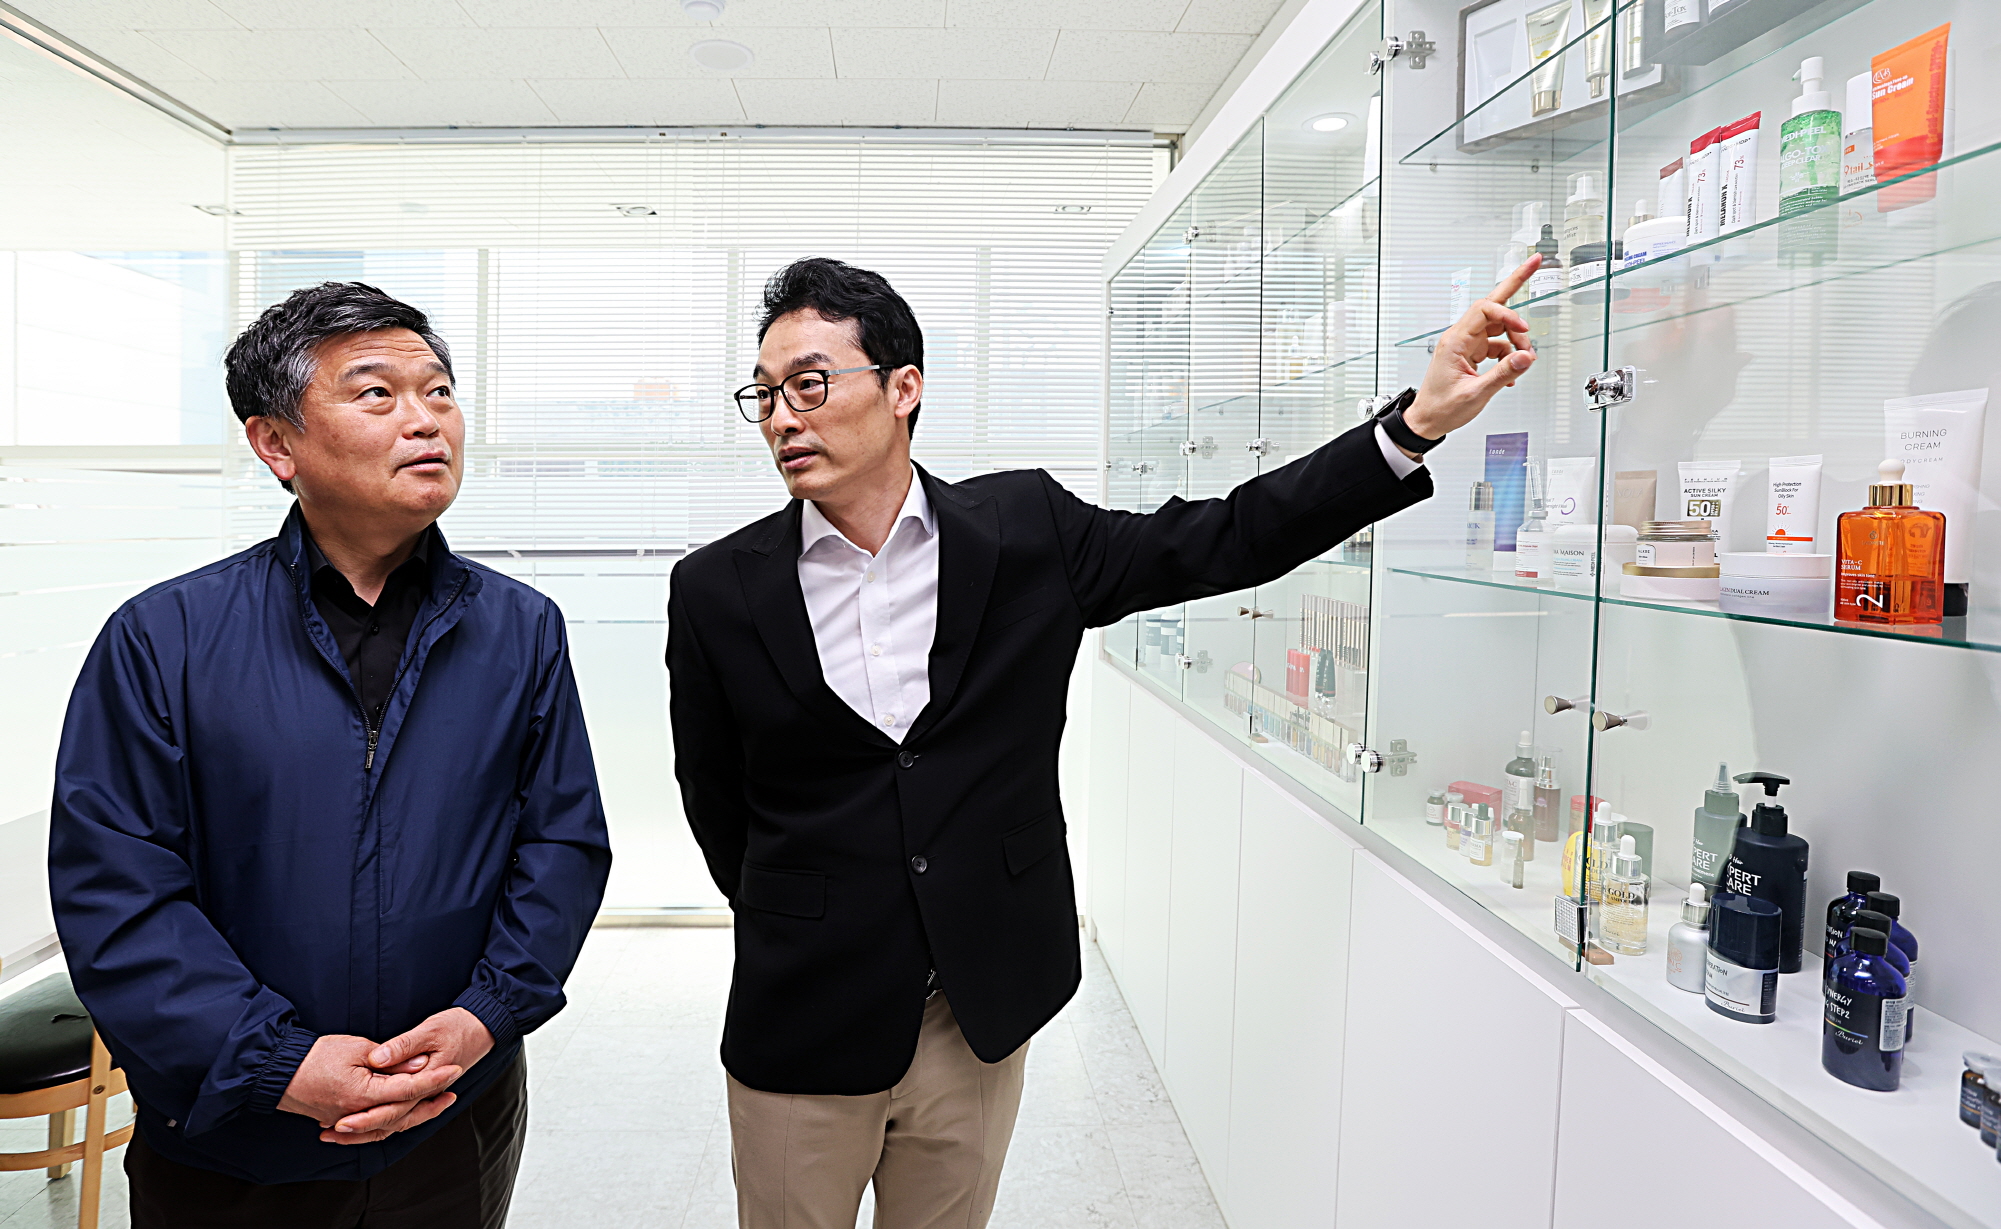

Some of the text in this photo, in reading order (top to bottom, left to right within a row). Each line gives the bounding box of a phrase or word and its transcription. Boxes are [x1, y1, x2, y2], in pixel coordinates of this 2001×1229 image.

[1887, 77, 1914, 94] Cream
[1901, 429, 1947, 439] BURNING
[1904, 442, 1941, 451] CREAM
[1689, 500, 1711, 517] 50
[1856, 594, 1883, 608] 2
[1693, 846, 1718, 862] PERT
[1693, 856, 1710, 870] ARE
[1727, 874, 1752, 896] ARE
